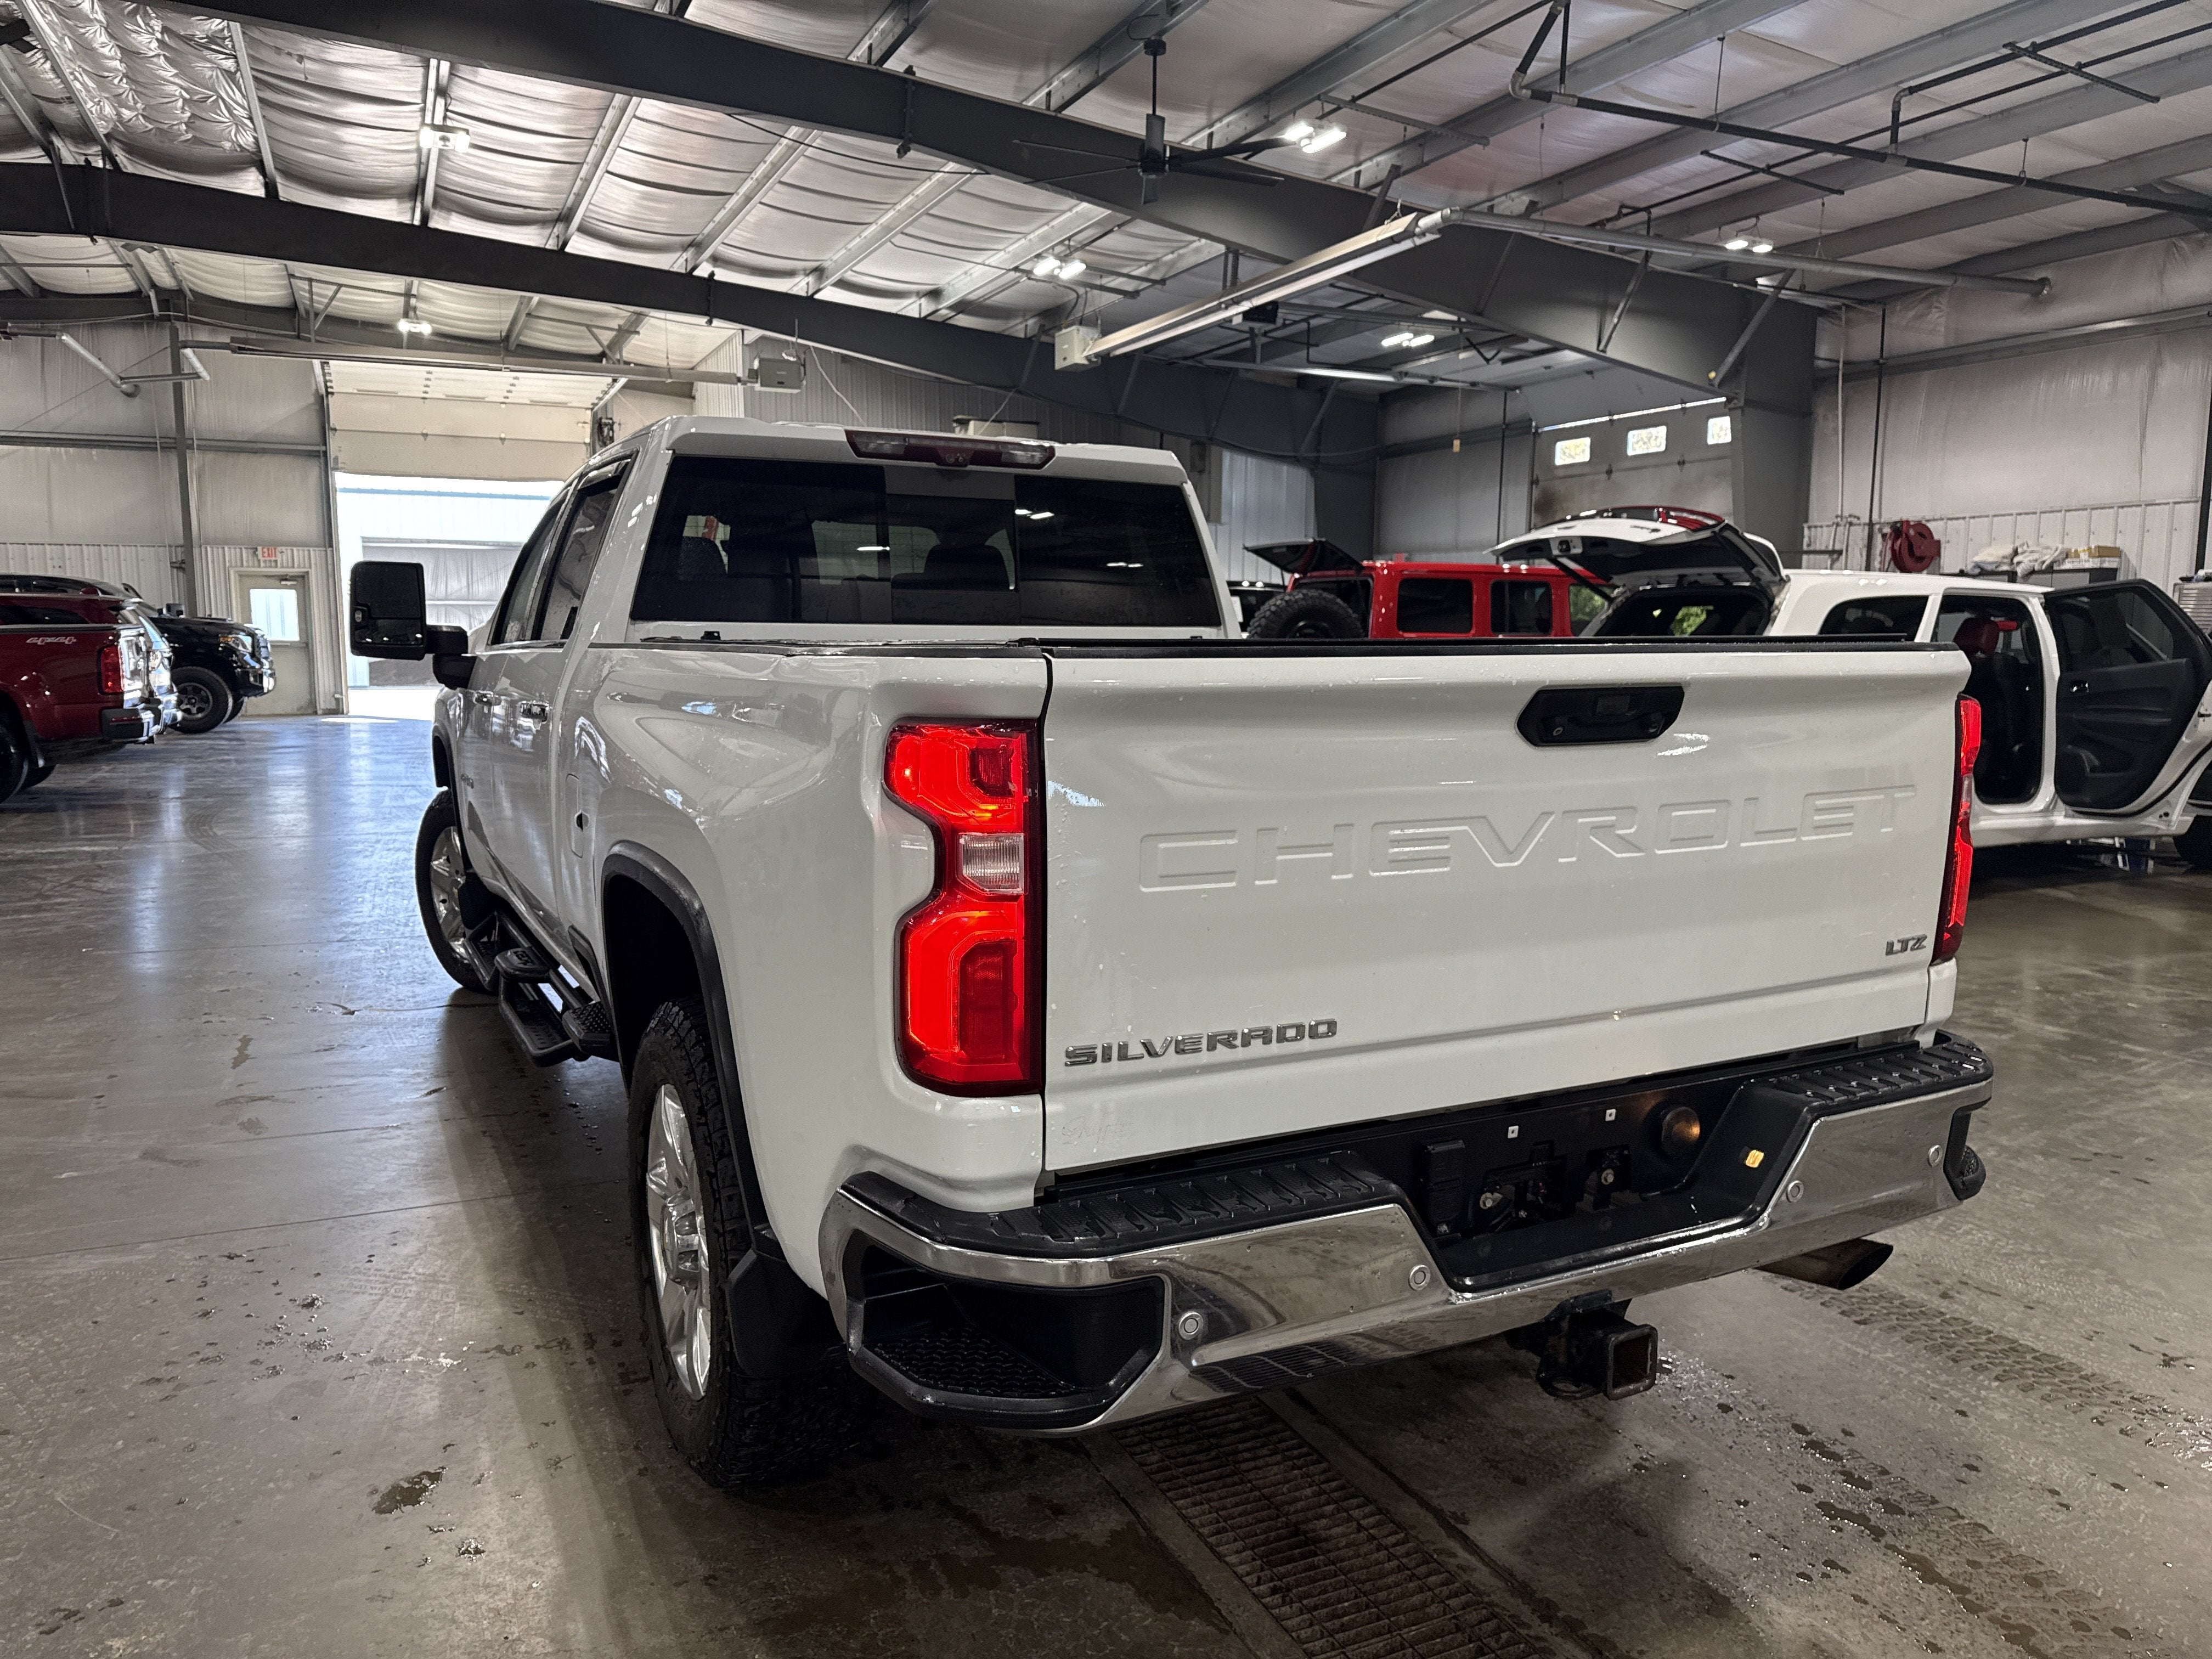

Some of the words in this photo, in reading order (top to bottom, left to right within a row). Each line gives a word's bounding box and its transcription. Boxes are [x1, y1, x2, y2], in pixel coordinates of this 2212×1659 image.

[261, 547, 277, 558] EXIT
[1140, 785, 1916, 893] CHEVROLET
[1885, 934, 1928, 956] LTZ
[1065, 1018, 1337, 1067] SILVERADO
